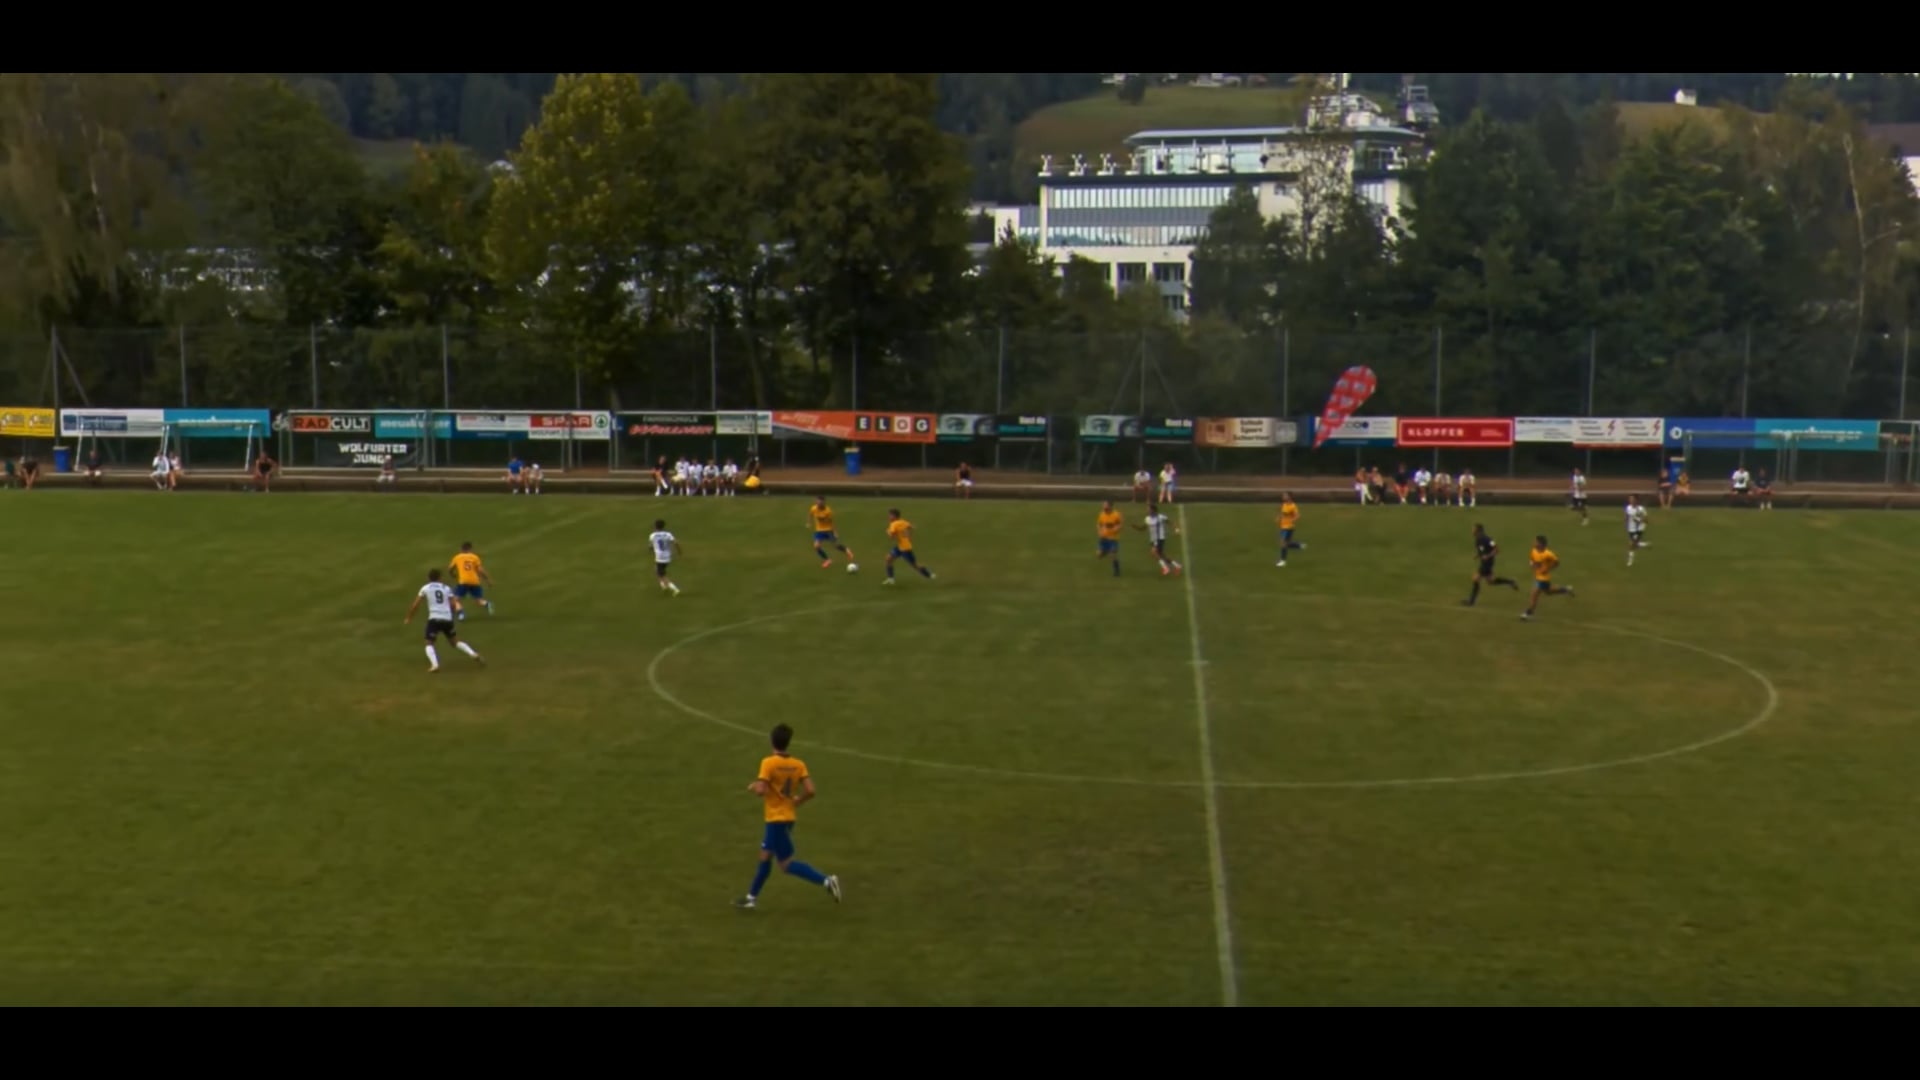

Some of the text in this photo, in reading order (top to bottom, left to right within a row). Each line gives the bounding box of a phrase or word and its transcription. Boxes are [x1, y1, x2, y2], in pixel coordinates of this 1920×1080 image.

[542, 416, 590, 427] SPAR
[1407, 428, 1464, 437] KLOPFER
[338, 442, 407, 454] WOLFURTER
[434, 589, 444, 604] 9
